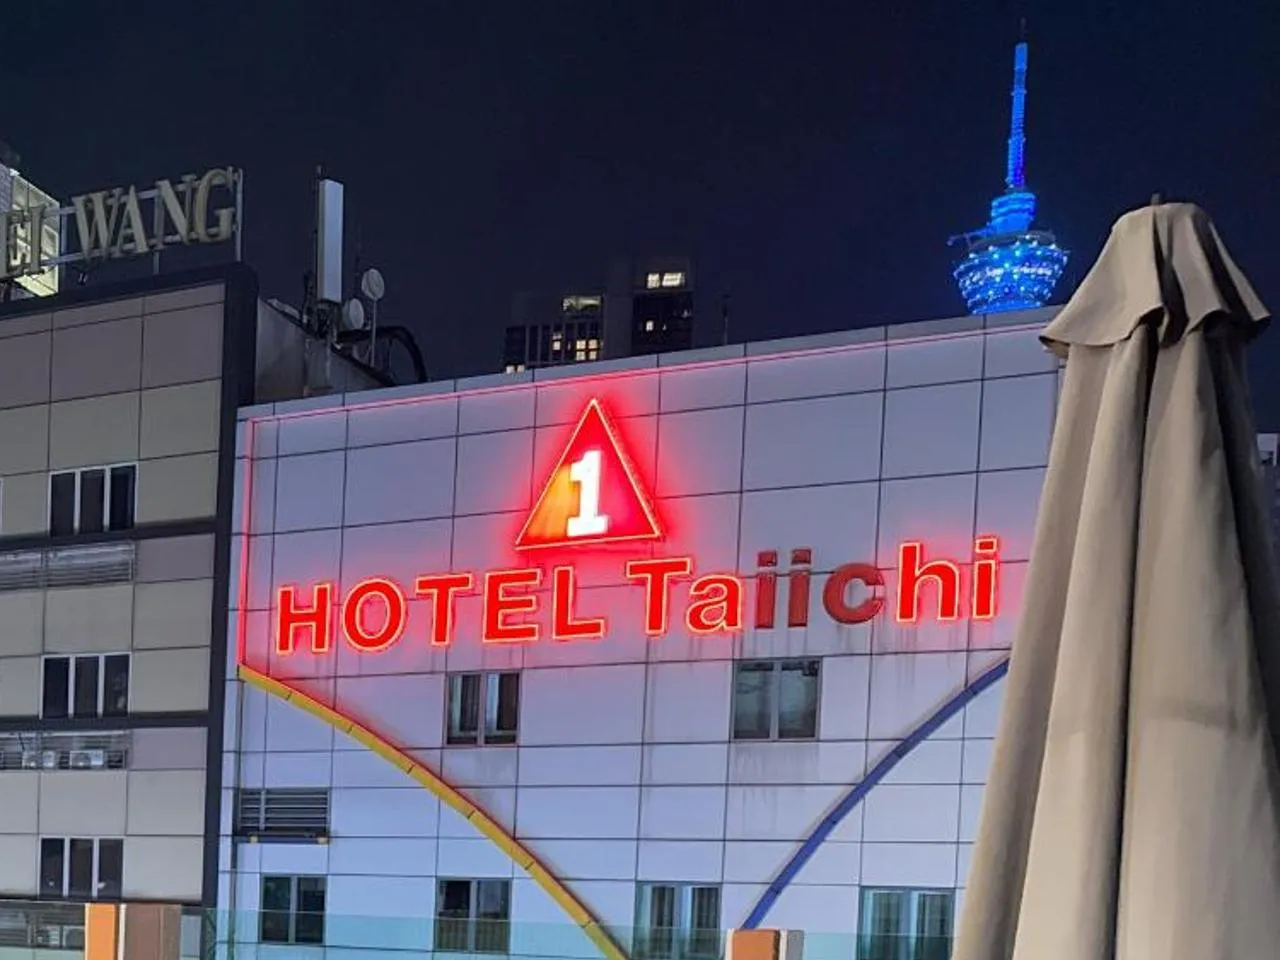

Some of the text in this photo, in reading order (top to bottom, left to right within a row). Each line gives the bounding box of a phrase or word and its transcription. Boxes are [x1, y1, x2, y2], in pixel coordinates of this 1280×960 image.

[73, 168, 238, 260] WANG
[565, 449, 609, 537] 1
[275, 535, 1001, 656] HOTEL Taiichi
